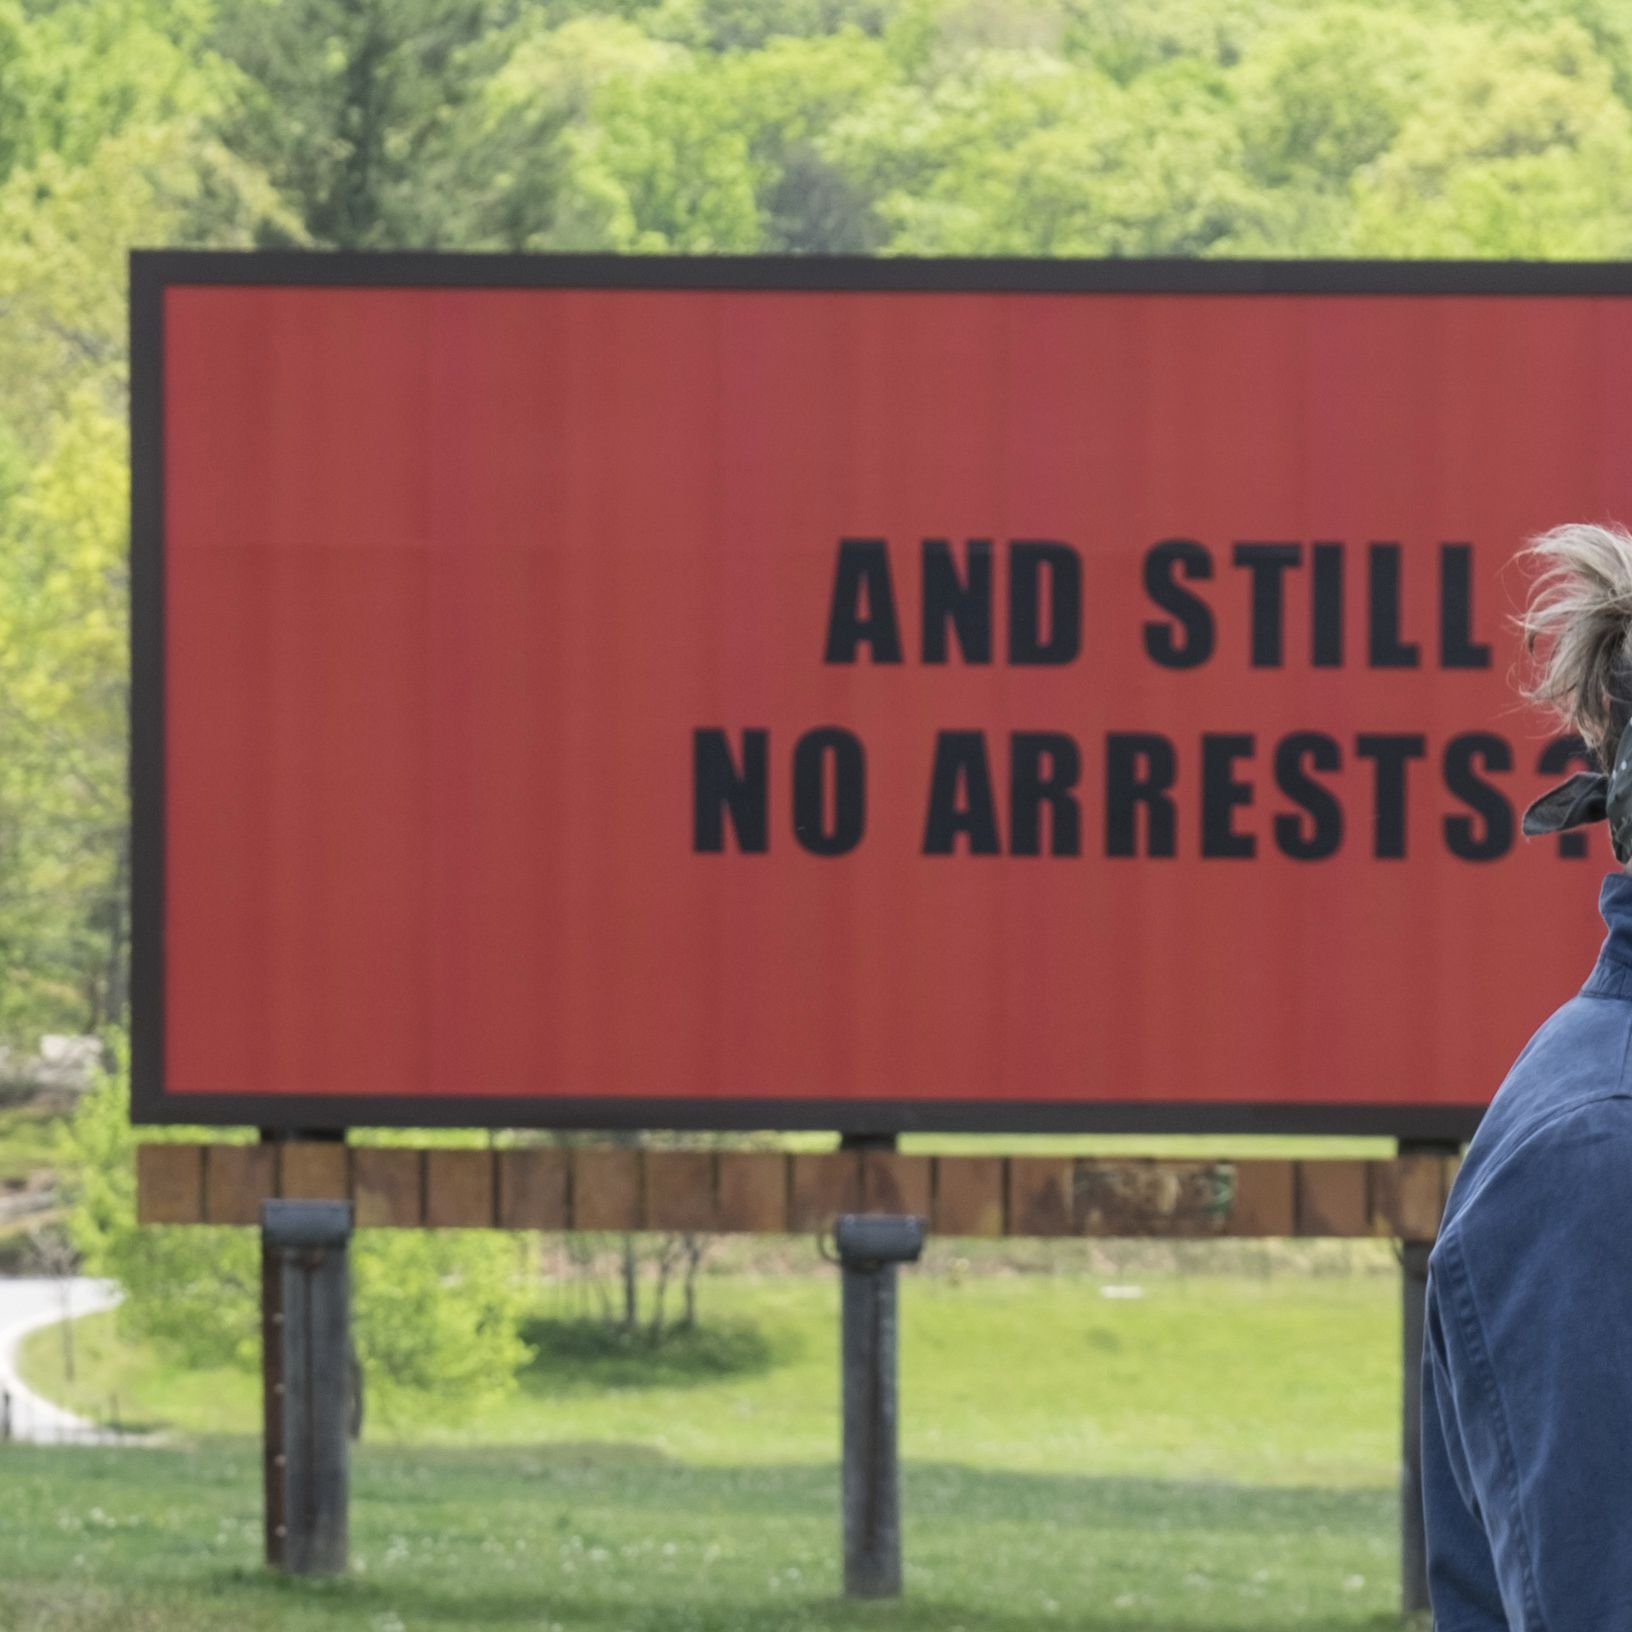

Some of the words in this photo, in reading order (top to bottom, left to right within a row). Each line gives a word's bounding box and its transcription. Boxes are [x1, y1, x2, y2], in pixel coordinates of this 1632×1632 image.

[821, 537, 1085, 668] AND
[1140, 538, 1494, 673] STILL
[691, 725, 868, 860] NO
